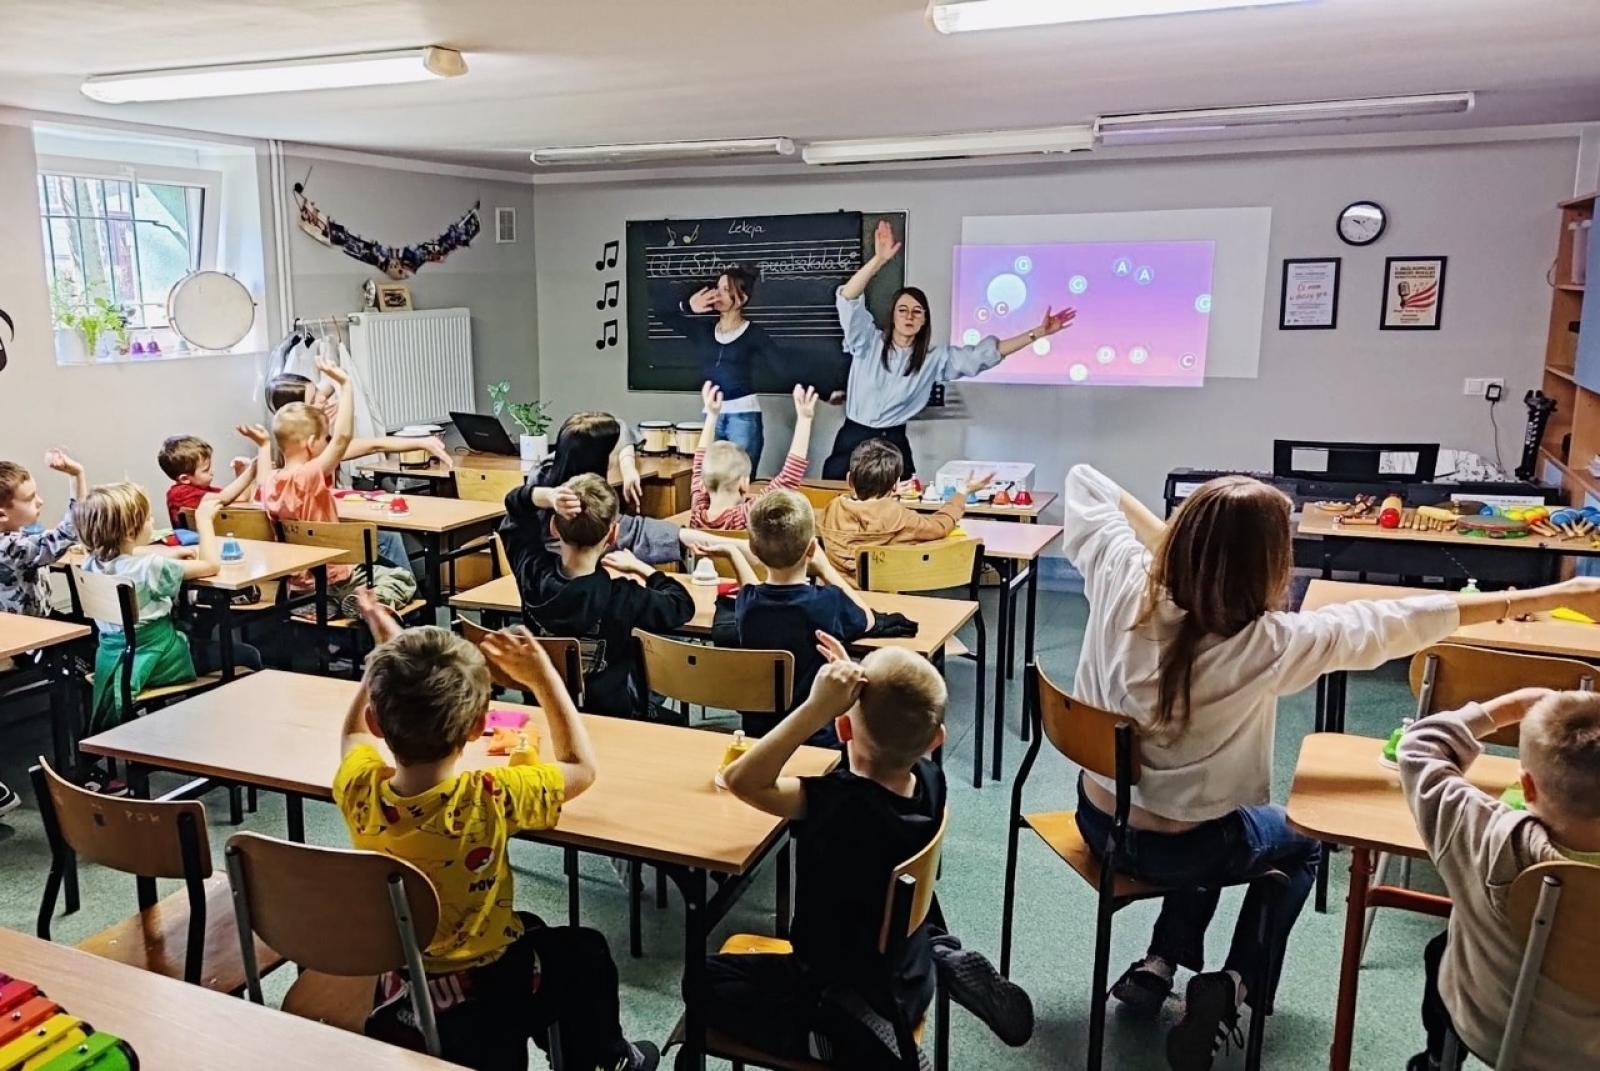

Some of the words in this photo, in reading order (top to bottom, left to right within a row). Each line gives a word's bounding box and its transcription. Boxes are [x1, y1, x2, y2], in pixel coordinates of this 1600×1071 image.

[728, 220, 765, 239] Lekcja
[1117, 261, 1127, 273] A
[1139, 269, 1150, 281] A
[978, 309, 988, 320] C
[997, 304, 1007, 315] C
[1182, 355, 1194, 366] C
